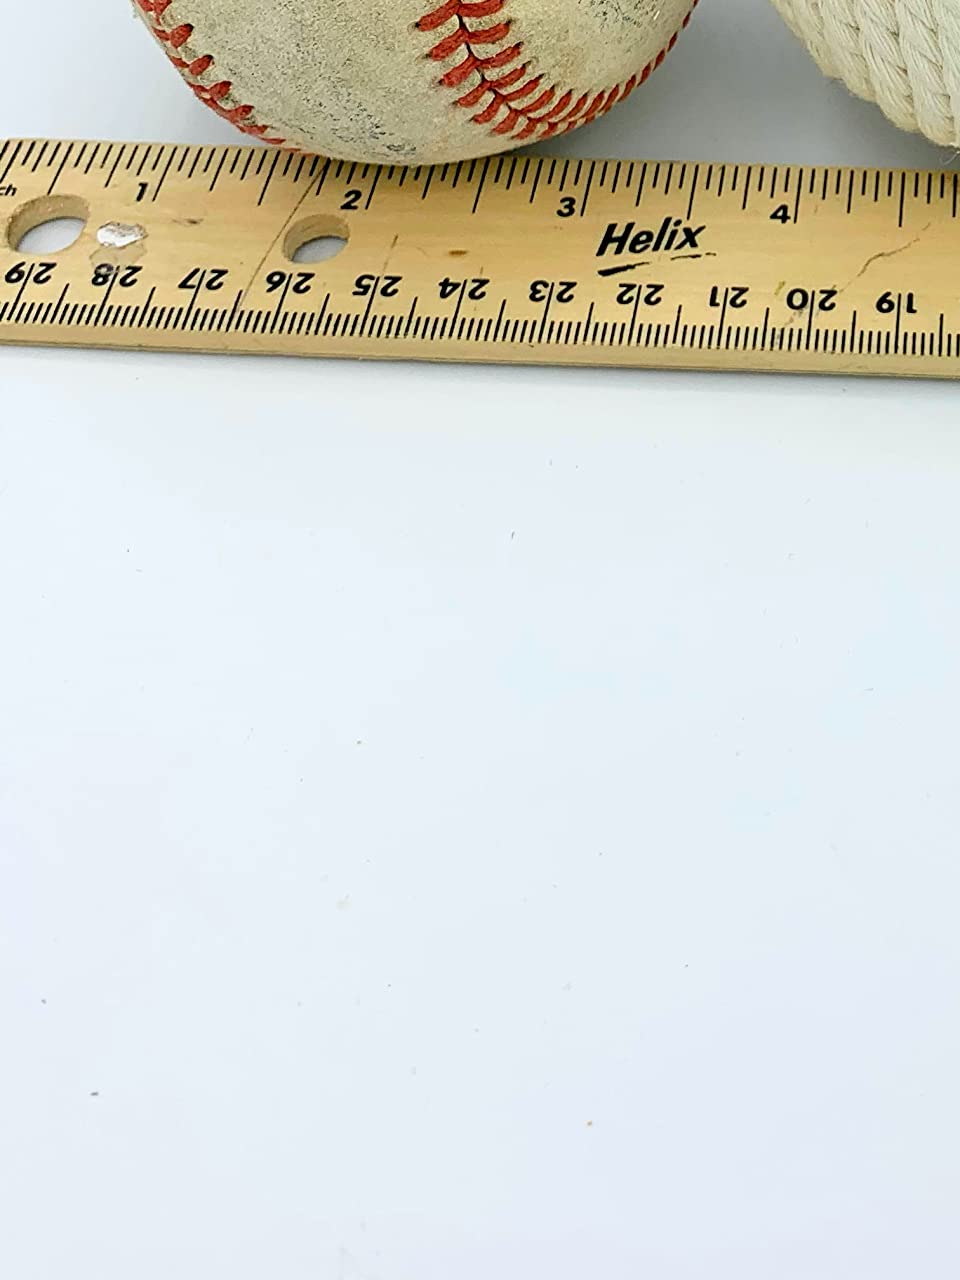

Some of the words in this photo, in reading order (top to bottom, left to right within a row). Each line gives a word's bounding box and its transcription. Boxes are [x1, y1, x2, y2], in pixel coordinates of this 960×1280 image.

[135, 182, 148, 202] 1
[340, 190, 362, 210] 2
[556, 197, 576, 218] 3
[770, 204, 791, 224] 4
[595, 216, 706, 258] Helix
[4, 262, 57, 285] 29
[91, 263, 143, 288] 28
[178, 268, 229, 291] 27
[265, 271, 315, 295] 26
[352, 275, 403, 297] 25
[438, 276, 490, 301] 24
[529, 280, 577, 303] 23
[616, 282, 665, 306] 22
[709, 286, 749, 308] 21
[786, 288, 838, 312] 20
[875, 291, 918, 314] 19
